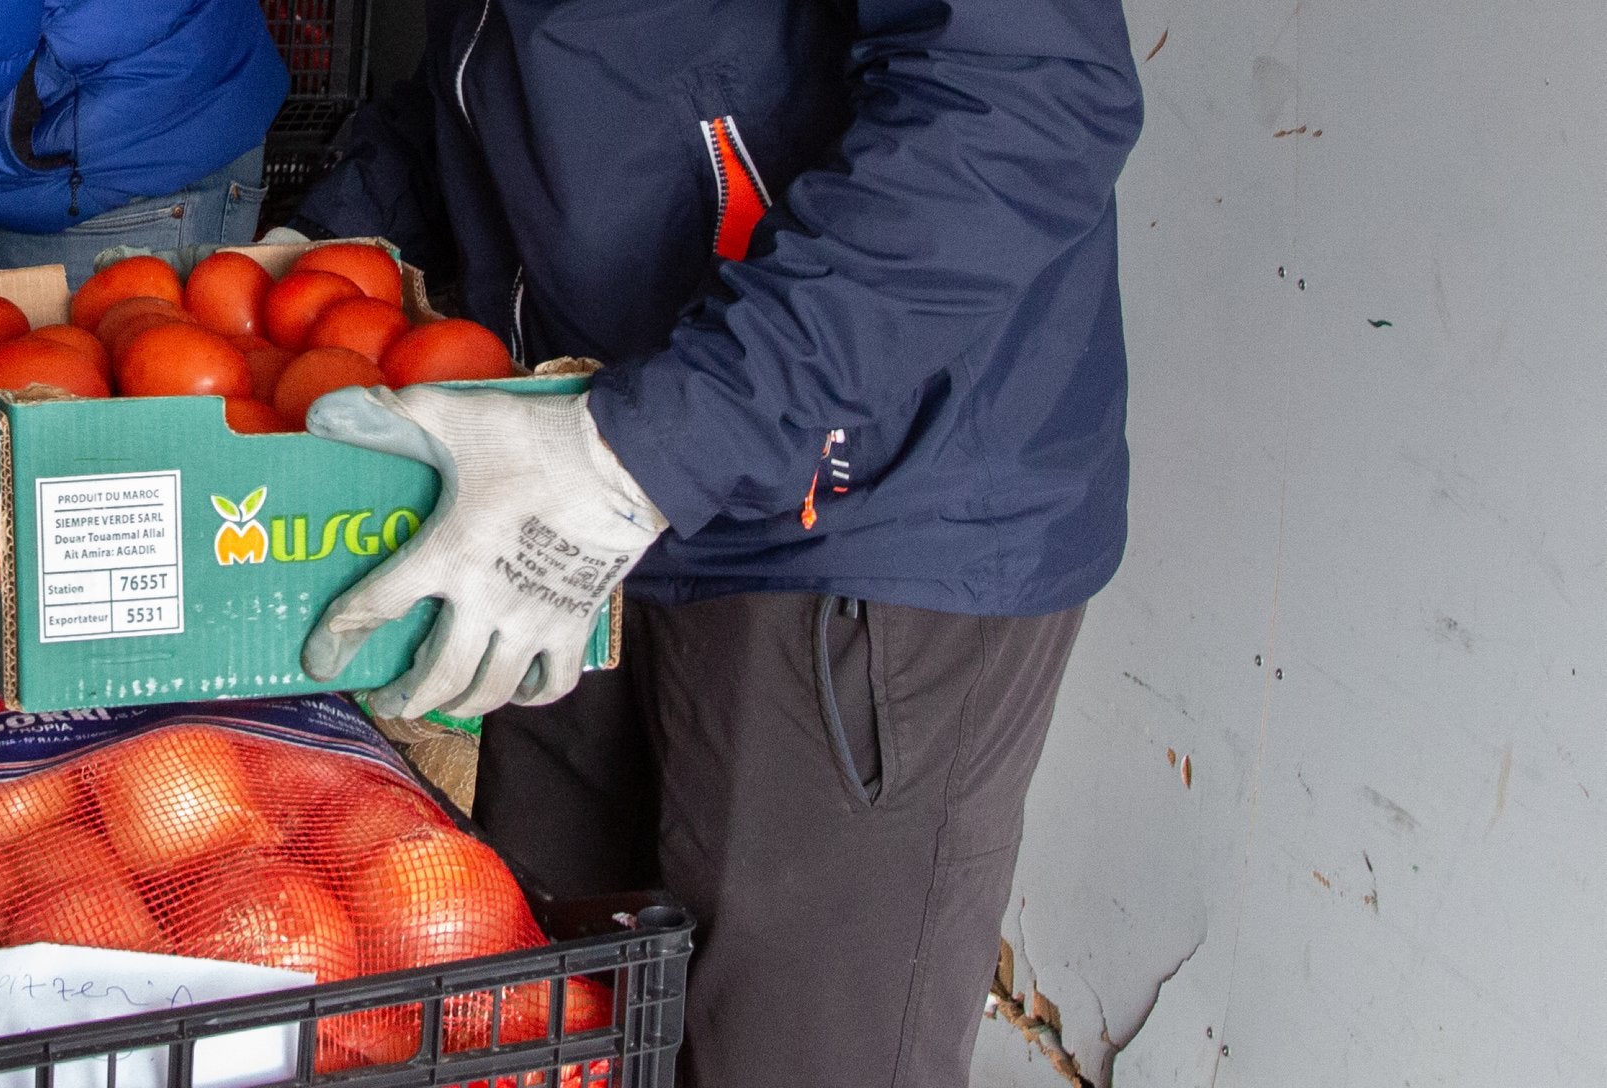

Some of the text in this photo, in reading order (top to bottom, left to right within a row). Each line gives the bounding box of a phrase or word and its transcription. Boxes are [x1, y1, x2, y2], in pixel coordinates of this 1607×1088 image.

[57, 489, 160, 505] PRODUIT DU MAROC
[55, 512, 164, 529] SIEMPRE VERDE SARL
[54, 527, 165, 545] Douar Touammal Allal
[64, 544, 157, 560] Ait Amira: AGADIR
[48, 573, 168, 595] Station 7655T
[495, 555, 594, 619] SAMURAI
[49, 606, 163, 627] Exportateur 5531
